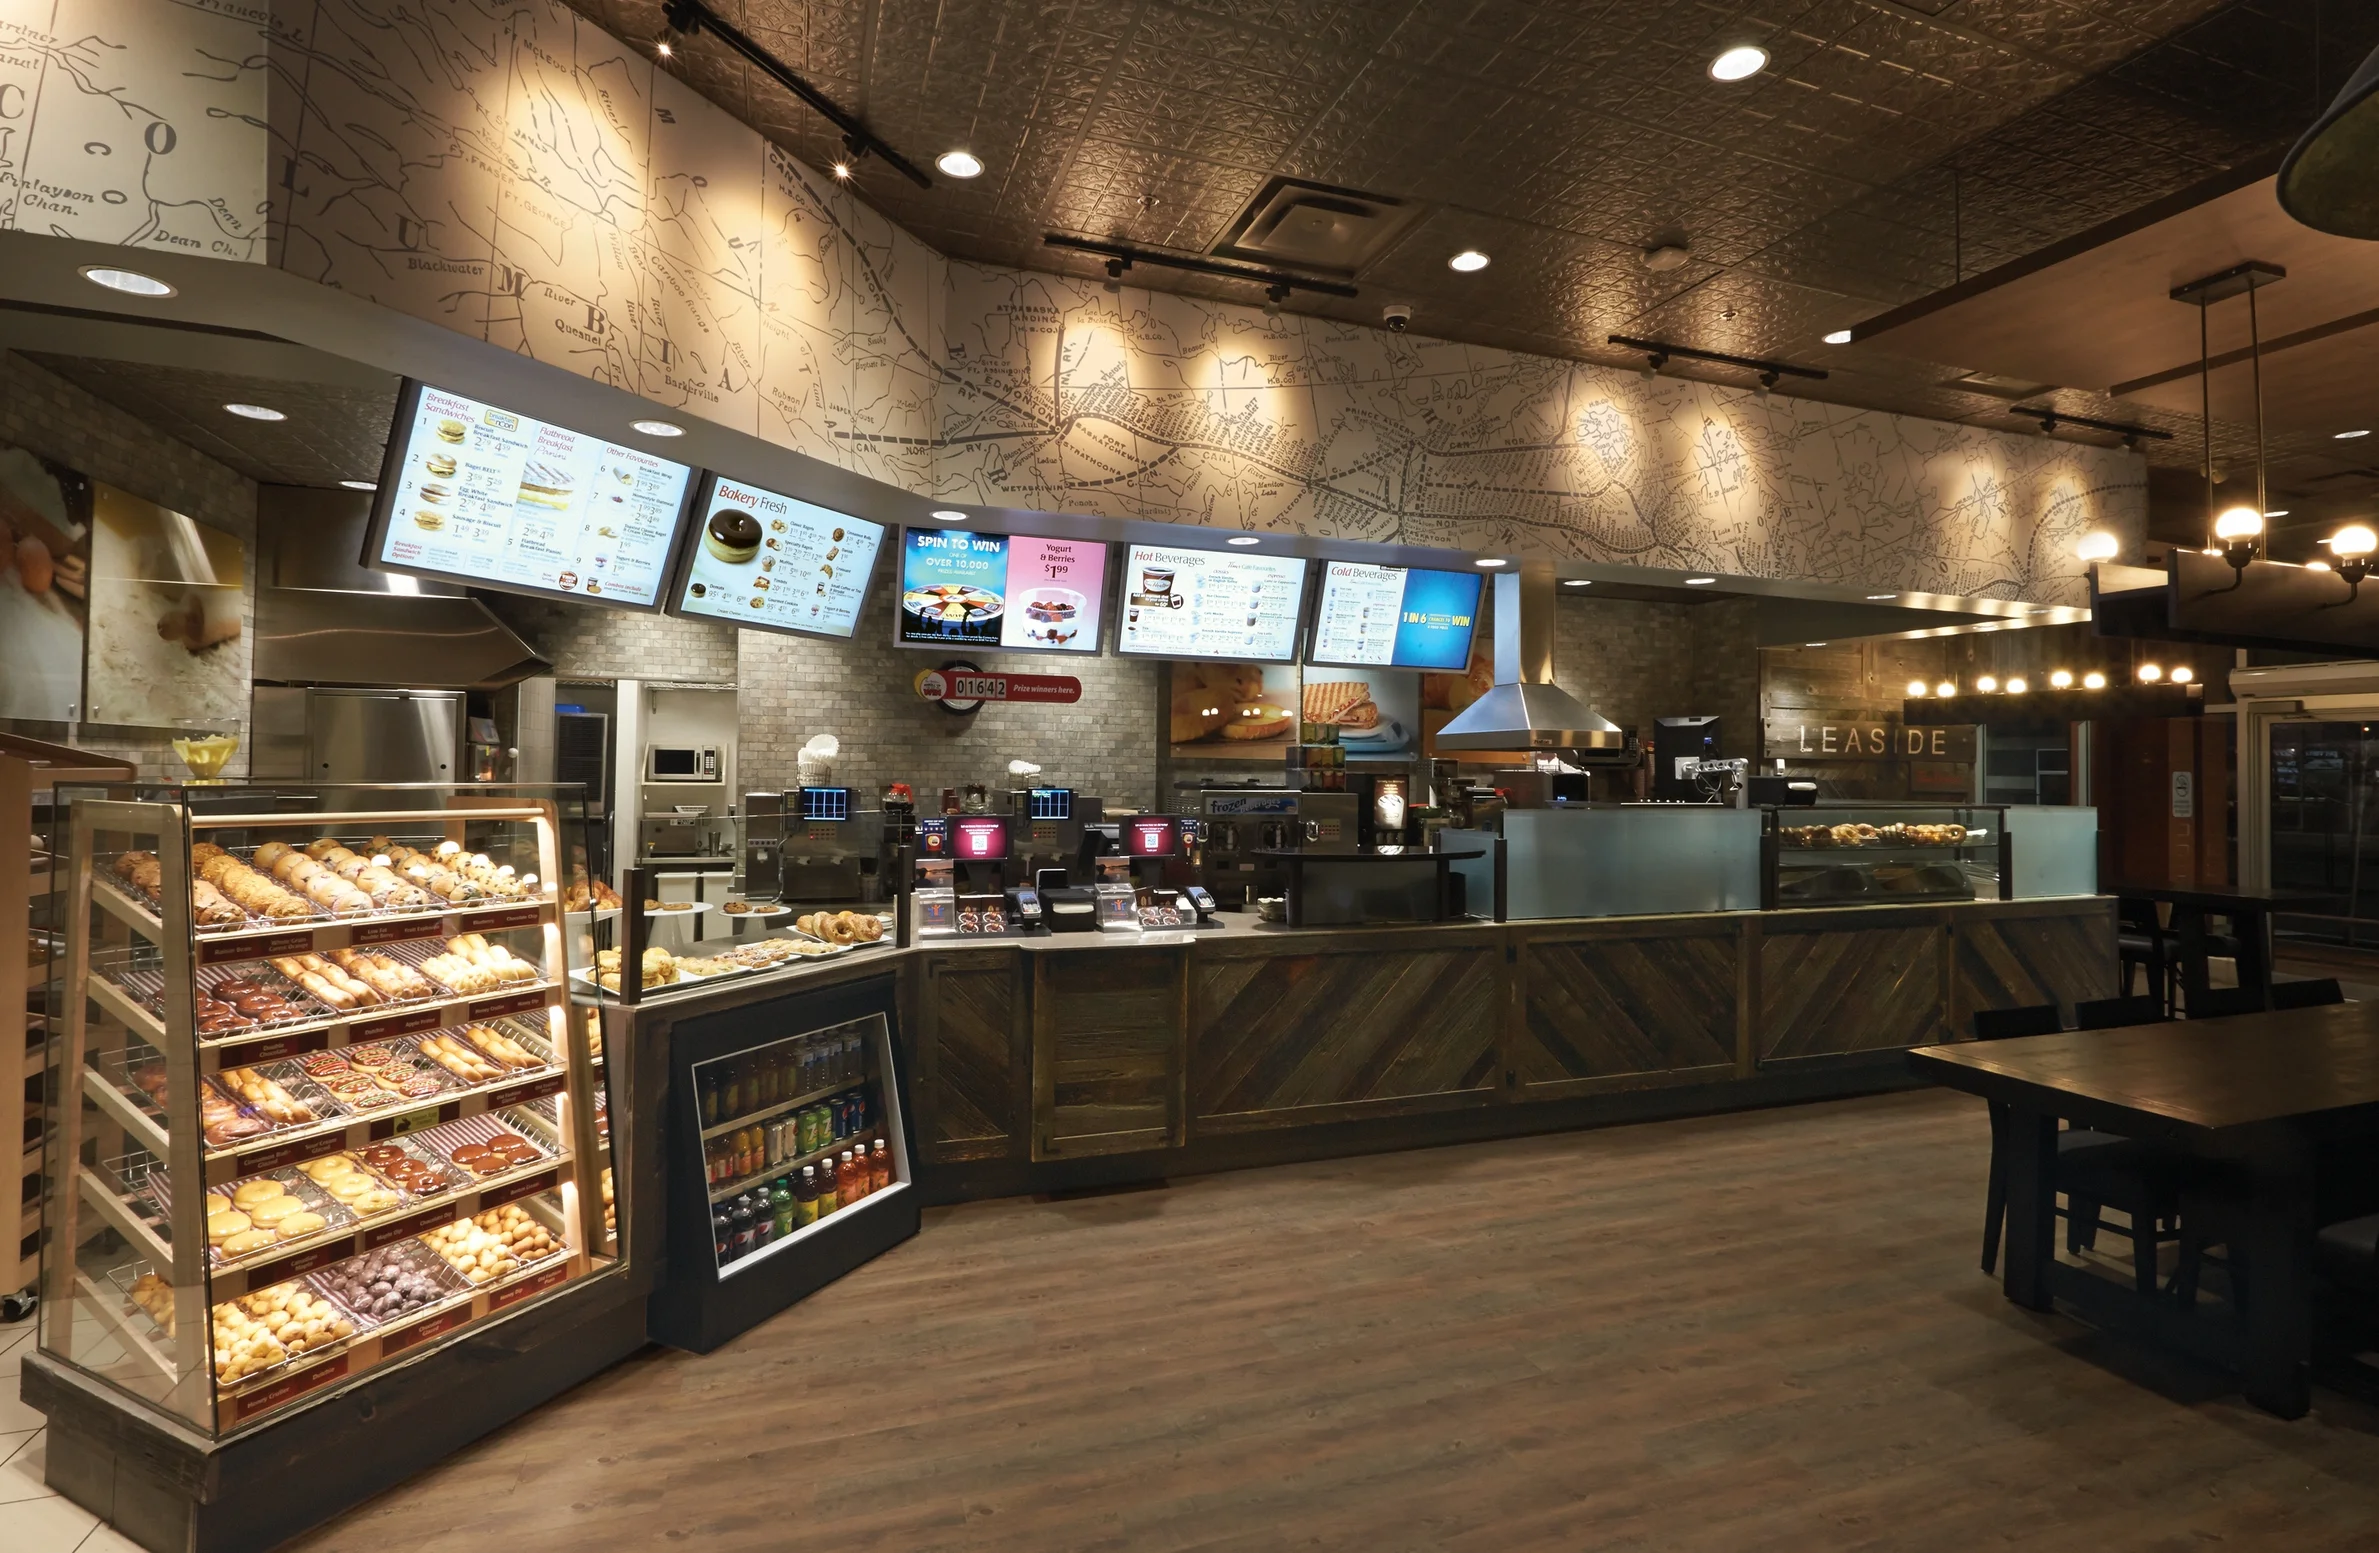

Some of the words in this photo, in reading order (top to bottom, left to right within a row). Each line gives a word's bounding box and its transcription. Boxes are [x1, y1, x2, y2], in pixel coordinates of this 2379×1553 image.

[153, 229, 201, 249] Dean
[406, 256, 485, 277] Blackwater
[543, 287, 577, 307] River
[555, 317, 602, 347] Quesnel
[664, 374, 719, 403] Barkerville
[771, 386, 801, 406] Robson
[426, 392, 470, 412] Breakfast
[778, 400, 798, 415] Peak
[423, 402, 476, 424] Sandwiches
[537, 435, 573, 453] Breakfast
[540, 427, 576, 444] Flatbread
[606, 446, 626, 459] Other
[626, 452, 660, 469] Favourites
[718, 484, 760, 509] Bakery
[759, 496, 788, 515] Fresh
[917, 535, 948, 549] SPIN
[952, 537, 969, 550] TO
[971, 540, 1001, 552] WIN
[1045, 543, 1072, 554] Yogurt
[926, 557, 952, 568] OVER
[955, 559, 989, 571] 10,000
[1047, 554, 1076, 564] Berries
[1134, 550, 1154, 561] Hot
[1154, 552, 1206, 567] Beverages
[1331, 566, 1352, 577] Cold
[1352, 568, 1398, 582] Beverages
[1403, 611, 1409, 623] 1
[1409, 612, 1419, 624] IN
[1420, 613, 1427, 624] 6
[1452, 615, 1471, 627] WIN
[1013, 683, 1030, 693] Prize
[1030, 684, 1057, 694] winners
[1057, 685, 1075, 695] here.
[1801, 724, 1946, 755] LEASIDE
[1210, 797, 1247, 814] frozen
